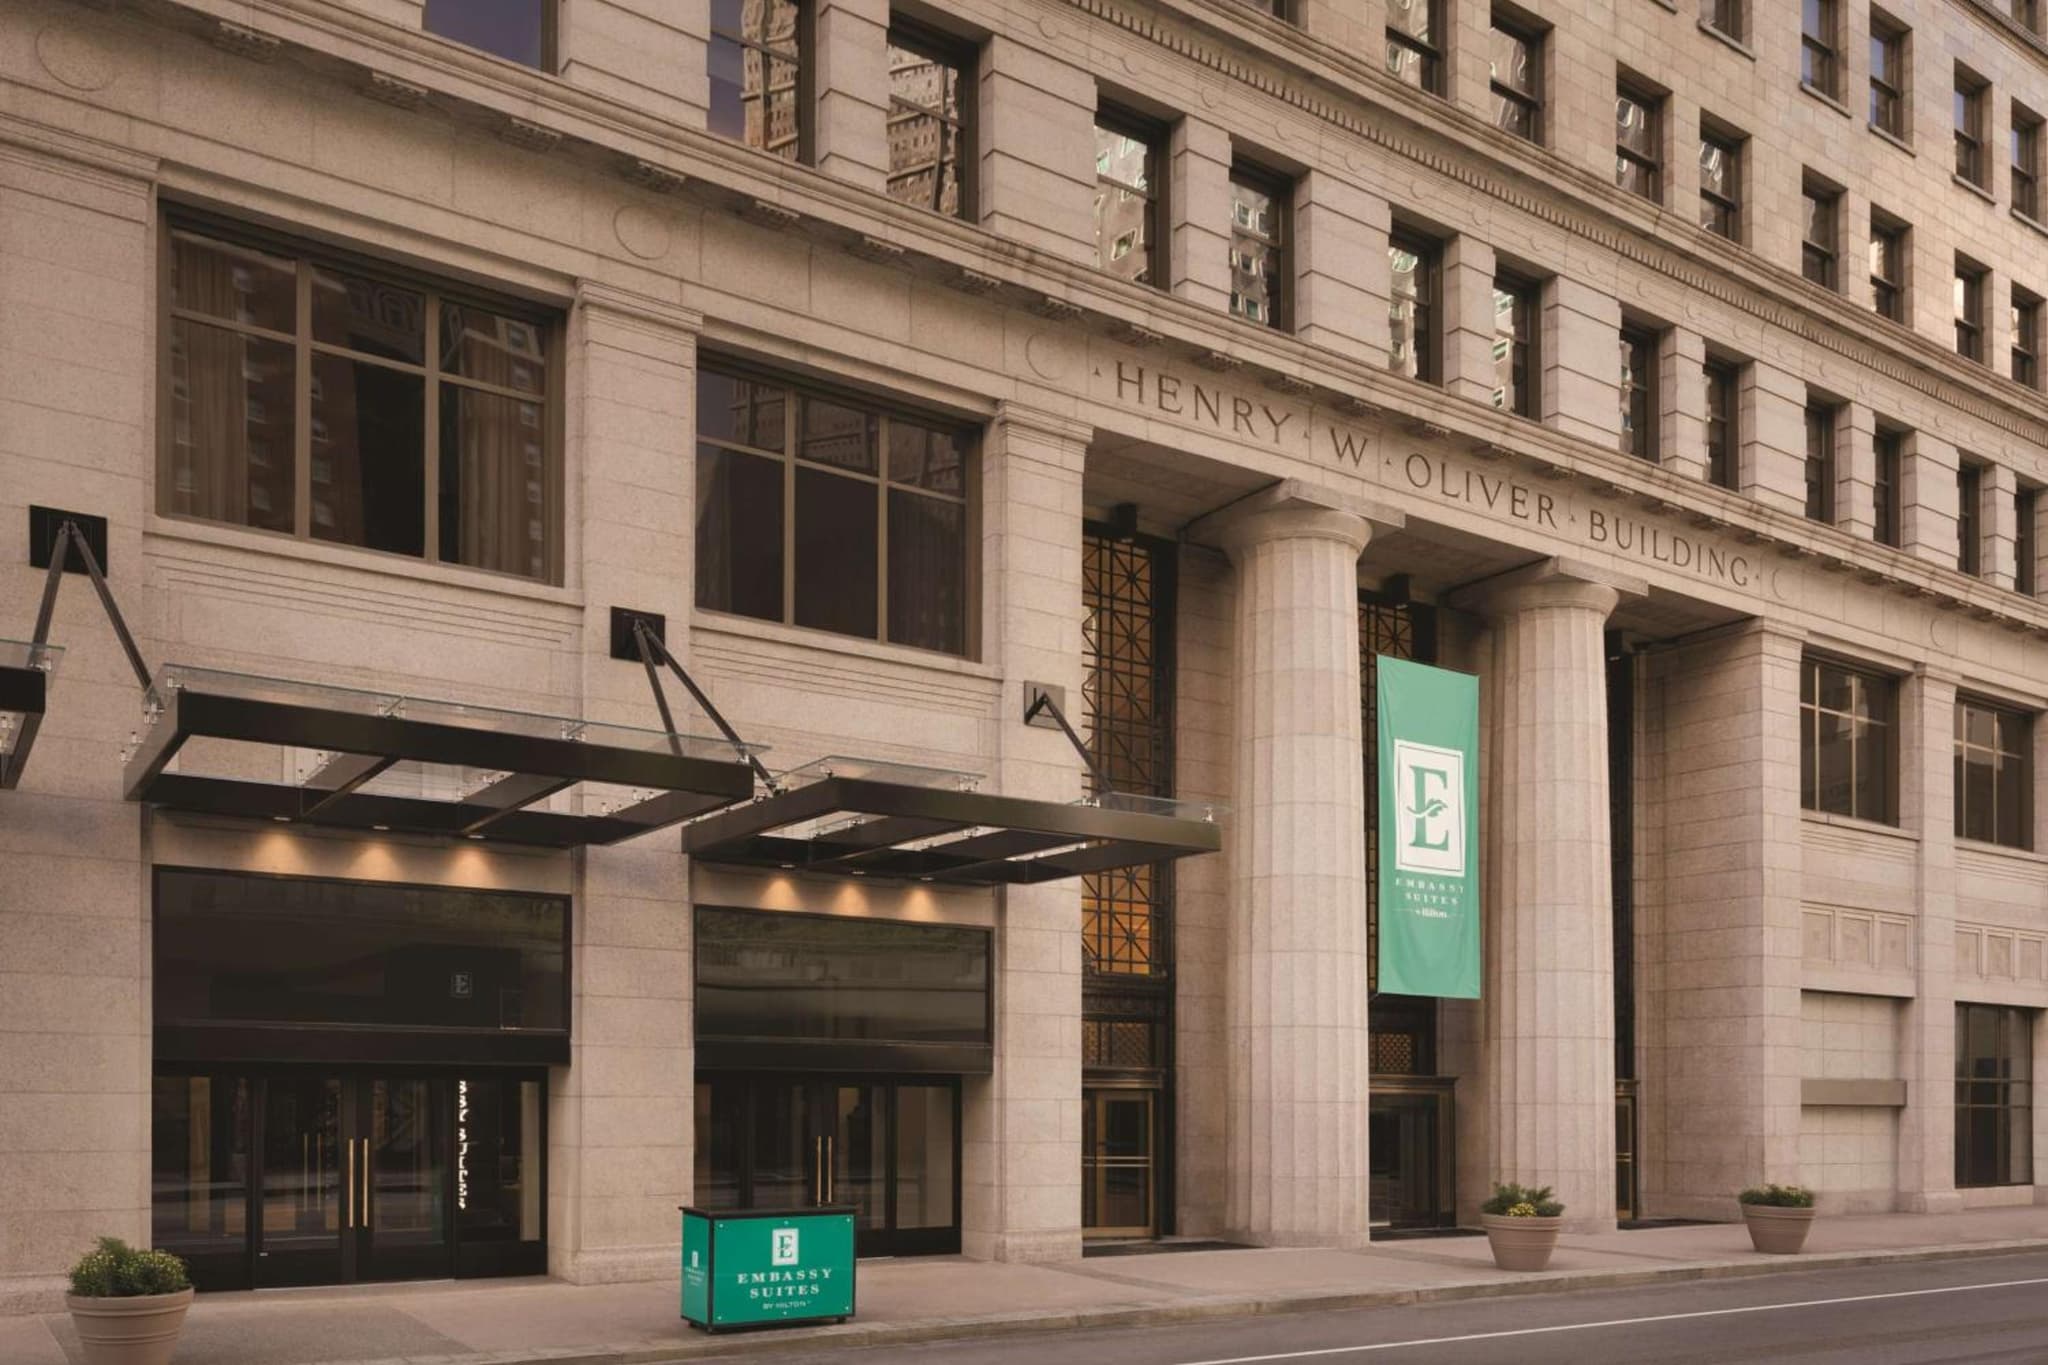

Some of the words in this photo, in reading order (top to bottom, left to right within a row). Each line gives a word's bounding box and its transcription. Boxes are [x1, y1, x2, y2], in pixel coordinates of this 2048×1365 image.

[1116, 361, 1292, 444] HENRY
[1330, 427, 1369, 467] W
[1405, 453, 1558, 529] OLIVER
[1589, 510, 1748, 587] BUILDING
[1407, 764, 1449, 851] E
[1395, 877, 1464, 894] EMBASSY
[1405, 892, 1458, 905] SUITES
[737, 1268, 832, 1284] EMBASSY
[750, 1284, 820, 1299] SUITES
